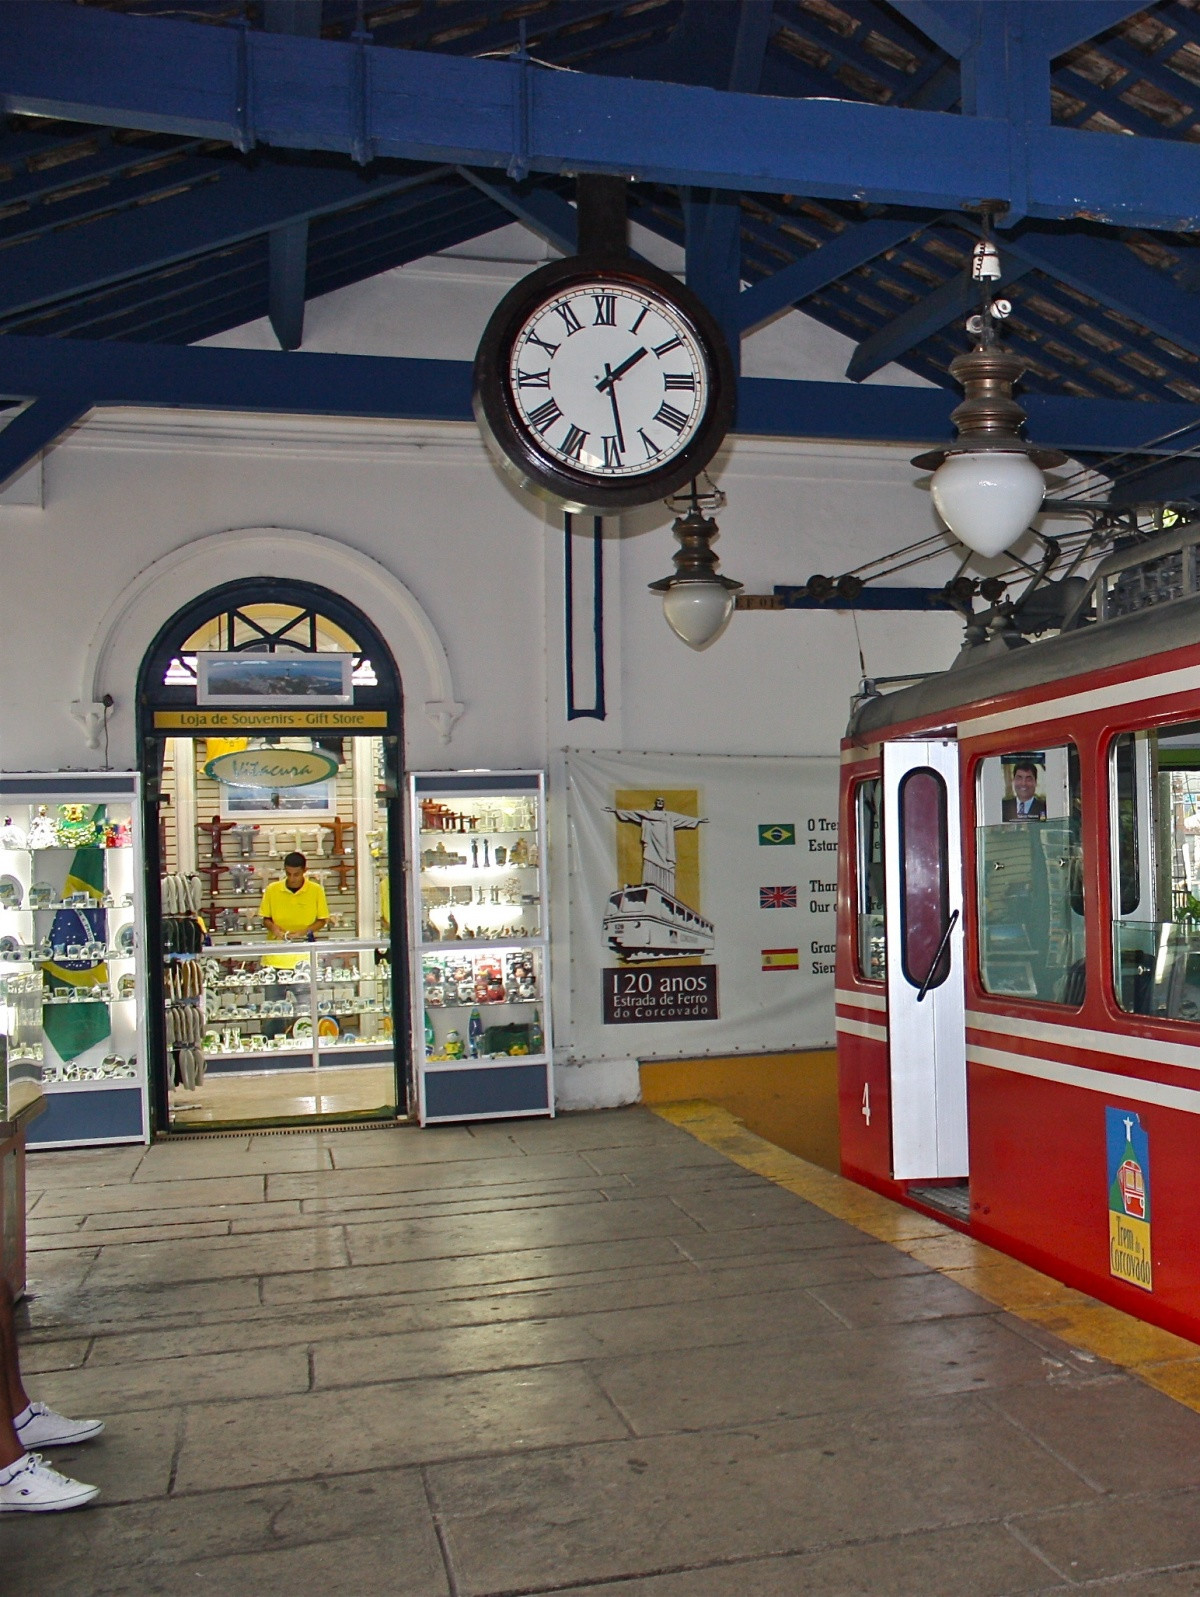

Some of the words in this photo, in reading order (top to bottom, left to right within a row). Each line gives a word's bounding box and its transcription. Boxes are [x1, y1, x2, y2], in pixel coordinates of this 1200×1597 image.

[551, 301, 586, 337] XI
[591, 295, 618, 327] XII
[525, 328, 561, 359] X
[651, 334, 684, 359] II
[517, 368, 550, 390] IX
[663, 372, 695, 392] III
[526, 397, 564, 436] VIII
[557, 423, 591, 461] VII
[600, 435, 625, 467] VI
[637, 427, 663, 460] V
[180, 714, 207, 726] Loja
[211, 713, 228, 725] de
[232, 713, 294, 725] Souvenirs
[306, 713, 329, 724] Gift
[333, 713, 364, 724] Store
[807, 818, 815, 831] O
[810, 900, 830, 913] Our
[811, 941, 837, 954] Grac
[613, 973, 652, 994] 120
[660, 976, 707, 992] anos
[613, 994, 656, 1007] Estrada
[659, 993, 674, 1005] de
[677, 993, 708, 1005] Ferro
[613, 1008, 630, 1018] do
[635, 1005, 708, 1018] Corcovado
[862, 1082, 871, 1126] 4
[1116, 1215, 1134, 1252] Trem
[1111, 1236, 1150, 1285] Corcovado
